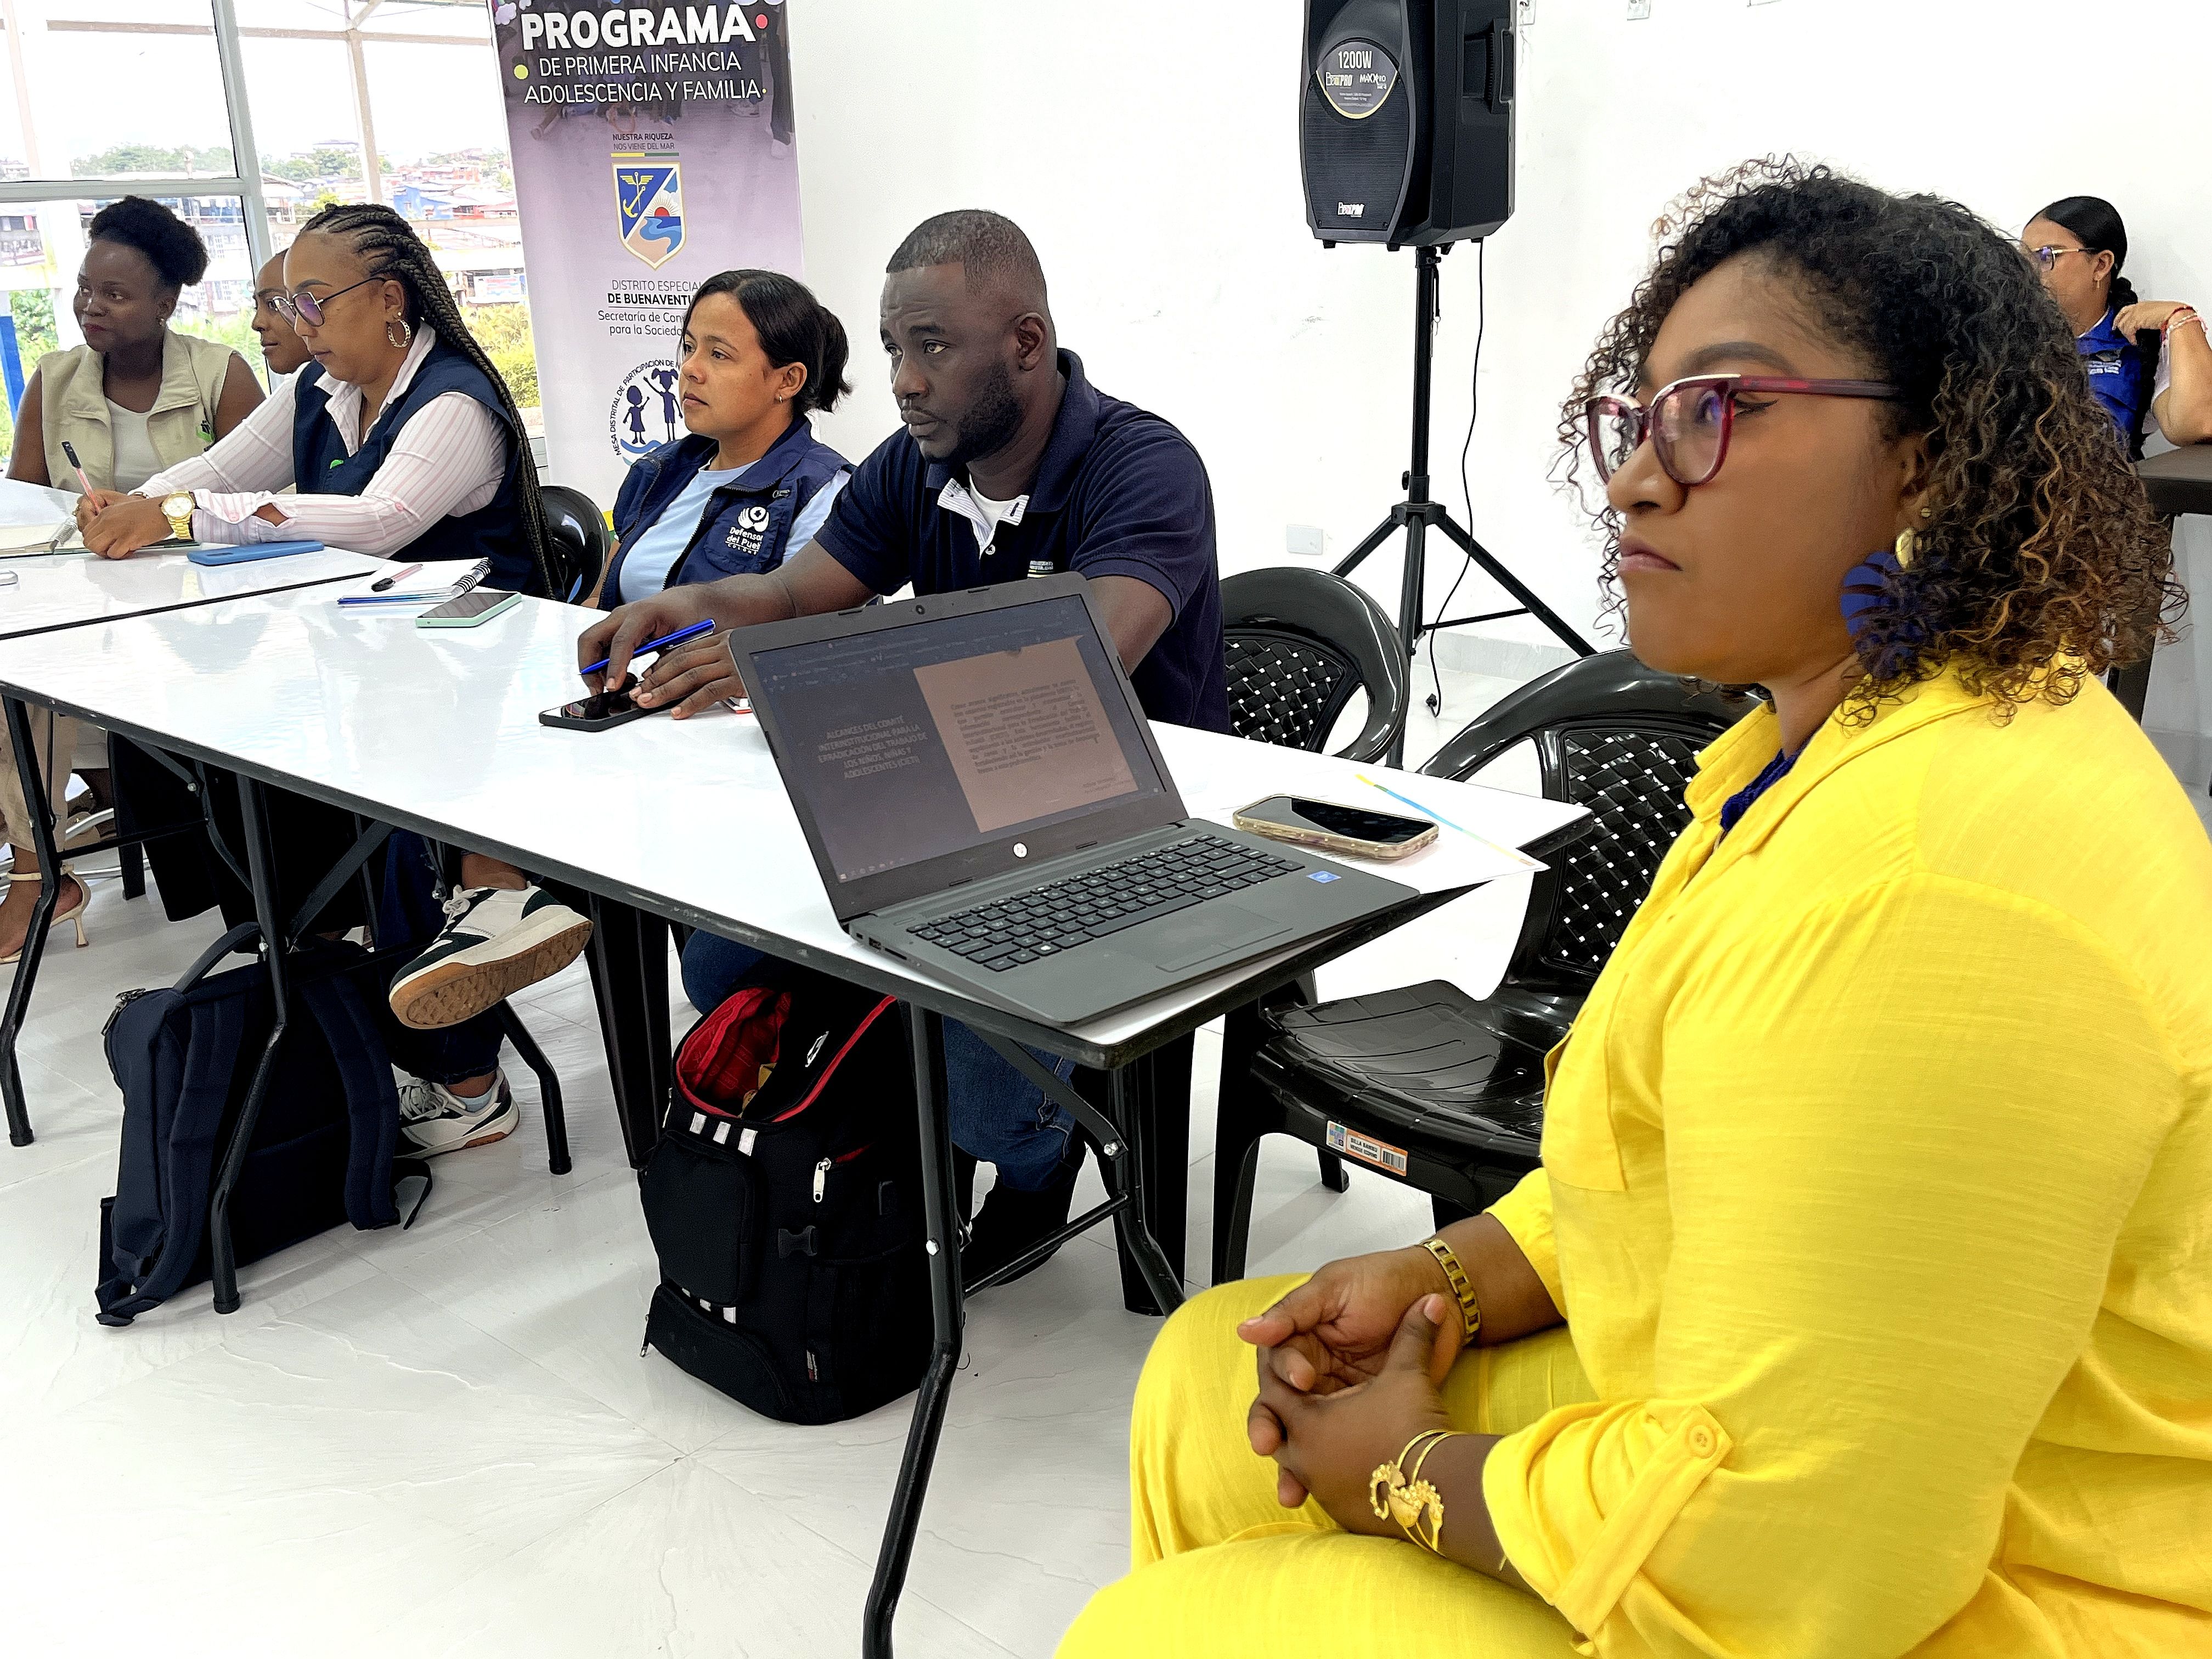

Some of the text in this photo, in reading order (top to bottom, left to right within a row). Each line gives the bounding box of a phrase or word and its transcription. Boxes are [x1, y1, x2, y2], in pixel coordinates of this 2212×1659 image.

[521, 4, 756, 50] PROGRAMA
[539, 51, 742, 76] DE PRIMERA INFANCIA
[1338, 50, 1372, 69] 1200W
[524, 79, 761, 104] ADOLESCENCIA Y FAMILIA
[644, 133, 674, 141] RIQUEZA
[612, 280, 656, 291] DISTRITO
[607, 293, 622, 303] DE
[598, 310, 646, 322] Secretaría
[648, 311, 661, 323] de
[610, 326, 631, 336] para
[634, 324, 642, 335] la
[616, 385, 625, 397] DE
[610, 397, 620, 432] DISTRITAL
[611, 434, 622, 455] MESA
[726, 534, 740, 544] del
